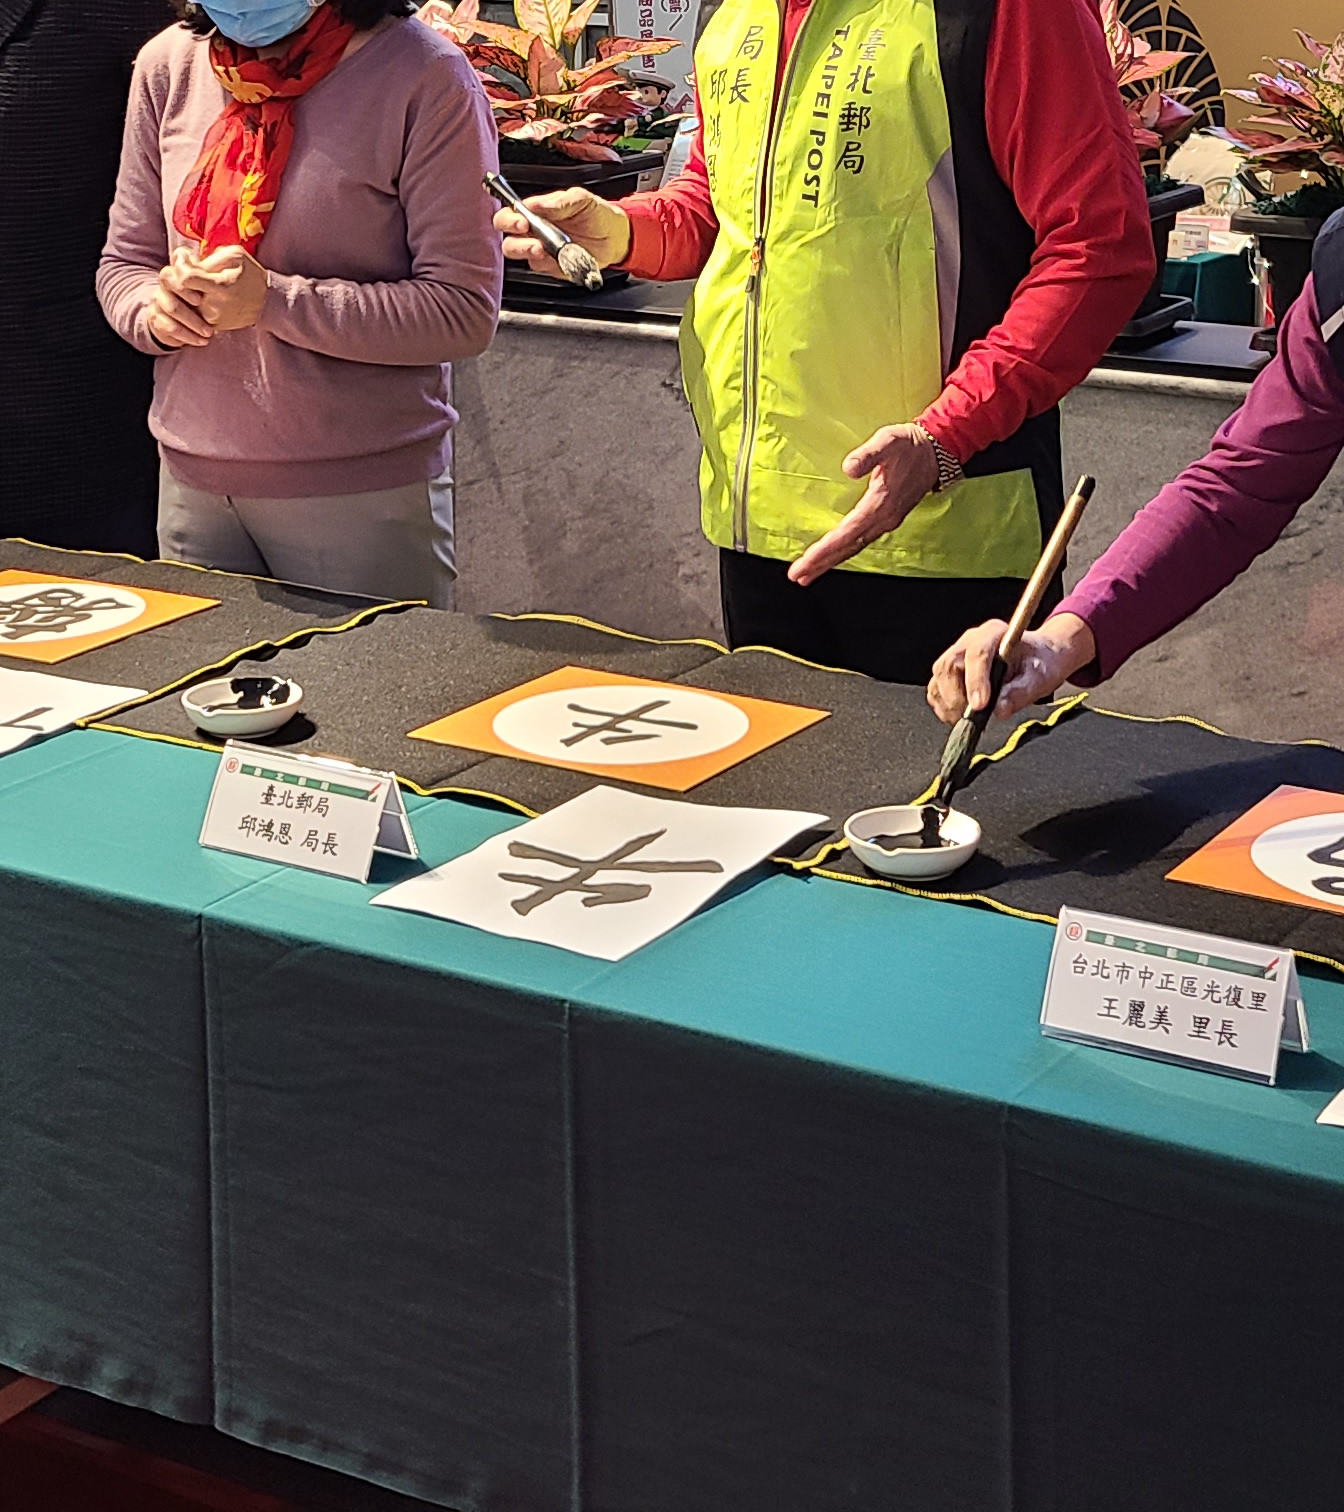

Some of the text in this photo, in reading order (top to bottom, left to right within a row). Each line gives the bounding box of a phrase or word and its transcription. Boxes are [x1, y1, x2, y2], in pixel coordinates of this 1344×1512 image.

[729, 26, 763, 103] 局長
[802, 25, 851, 208] TAIPEI POST
[835, 29, 886, 175] 臺北郵局
[559, 698, 699, 748] 牛
[259, 784, 330, 818] 臺北郵局
[237, 814, 339, 857] 邱鴻恩 局長
[497, 828, 725, 917] 牛
[1071, 953, 1269, 1013] 台北市中正區光復里
[1097, 997, 1240, 1049] 王麗美 里長
